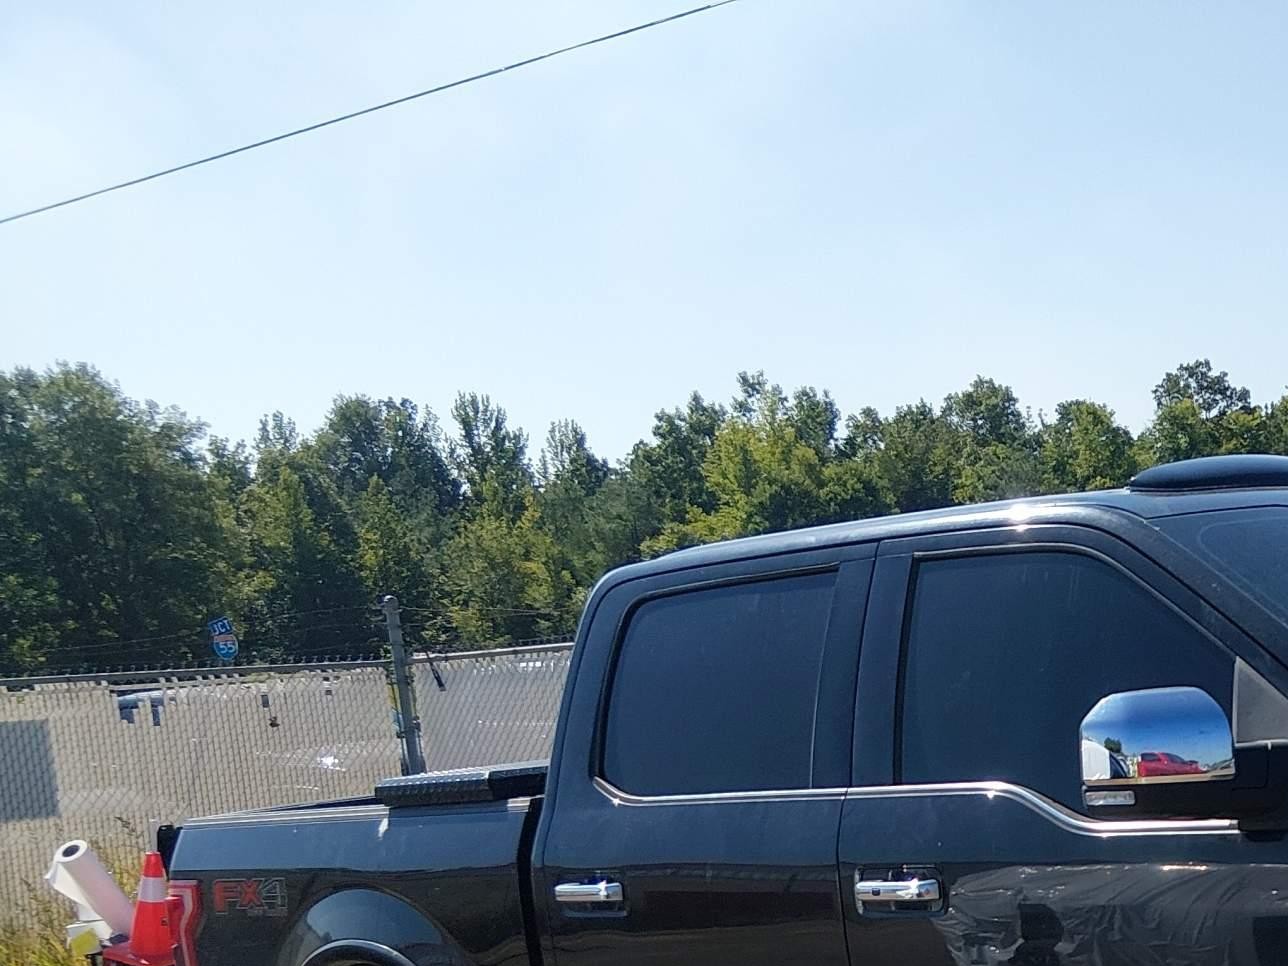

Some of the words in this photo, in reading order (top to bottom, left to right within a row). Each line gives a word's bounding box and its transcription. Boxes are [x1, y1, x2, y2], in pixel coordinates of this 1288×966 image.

[211, 620, 231, 635] JCT
[219, 641, 236, 654] 55
[213, 877, 289, 915] FX4
